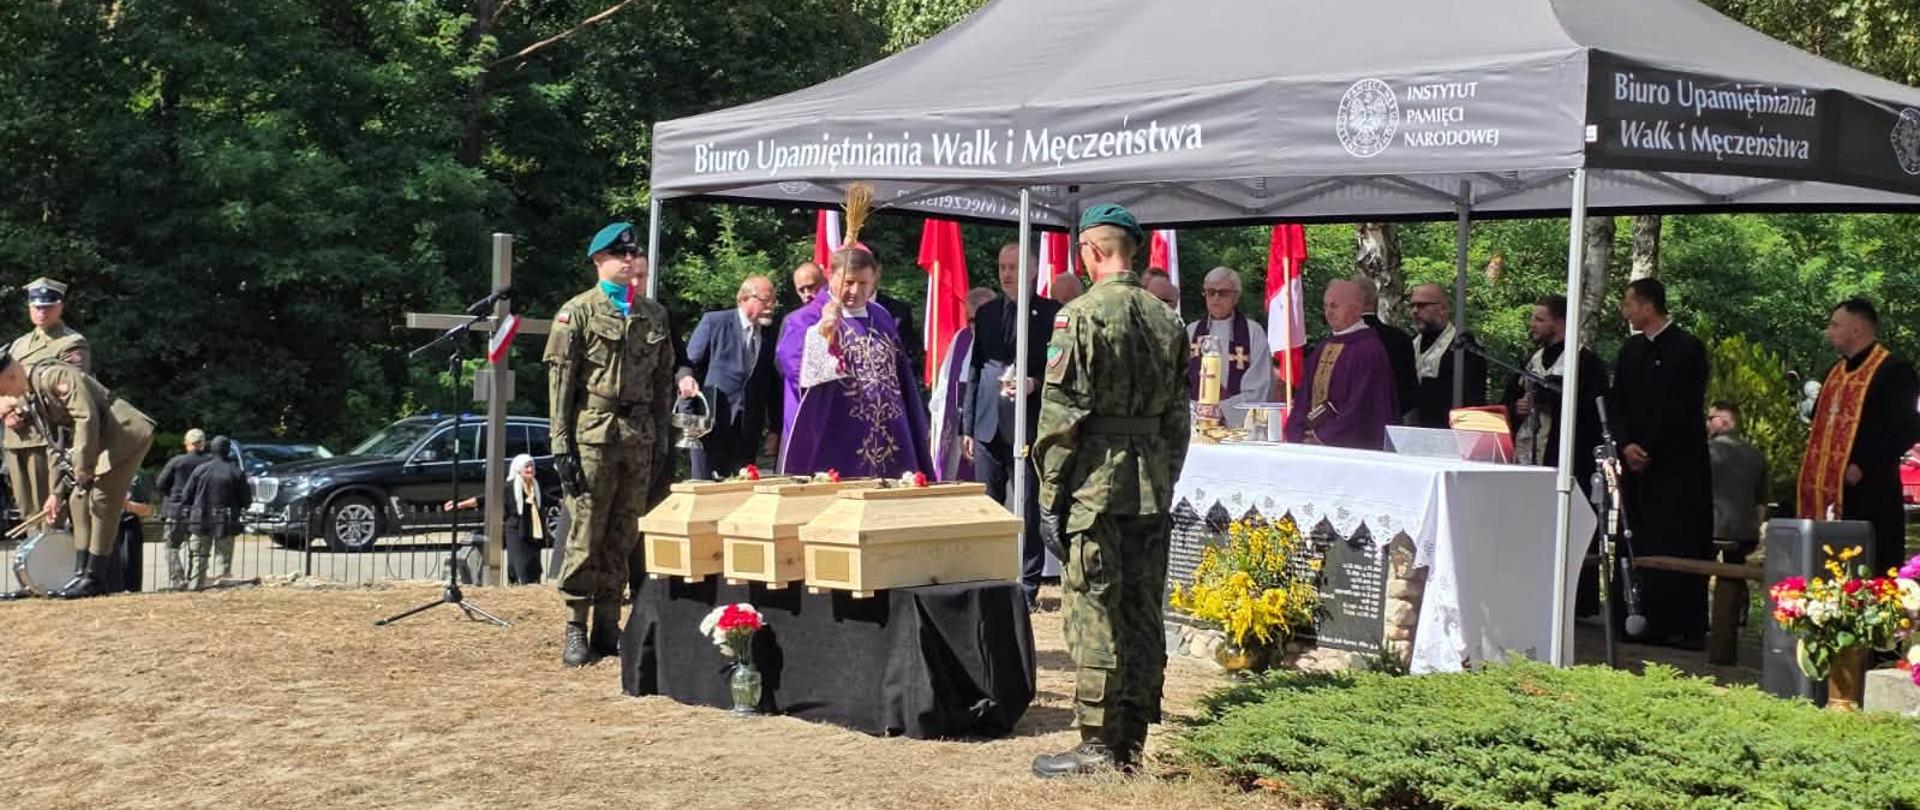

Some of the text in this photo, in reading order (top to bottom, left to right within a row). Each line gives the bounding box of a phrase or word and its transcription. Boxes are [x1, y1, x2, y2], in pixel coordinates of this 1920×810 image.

[1407, 82, 1478, 101] INSTYTUT
[1614, 72, 1816, 119] Biuro Upamiętniania
[1406, 106, 1464, 127] PAMIĘCI
[694, 113, 1203, 176] Biuro Upamiętniania Walk i Męczeństwa
[1404, 128, 1500, 147] NARODOWEJ
[1620, 119, 1675, 150] Walk
[1678, 121, 1686, 151] i
[1691, 125, 1810, 161] Męczeństwa
